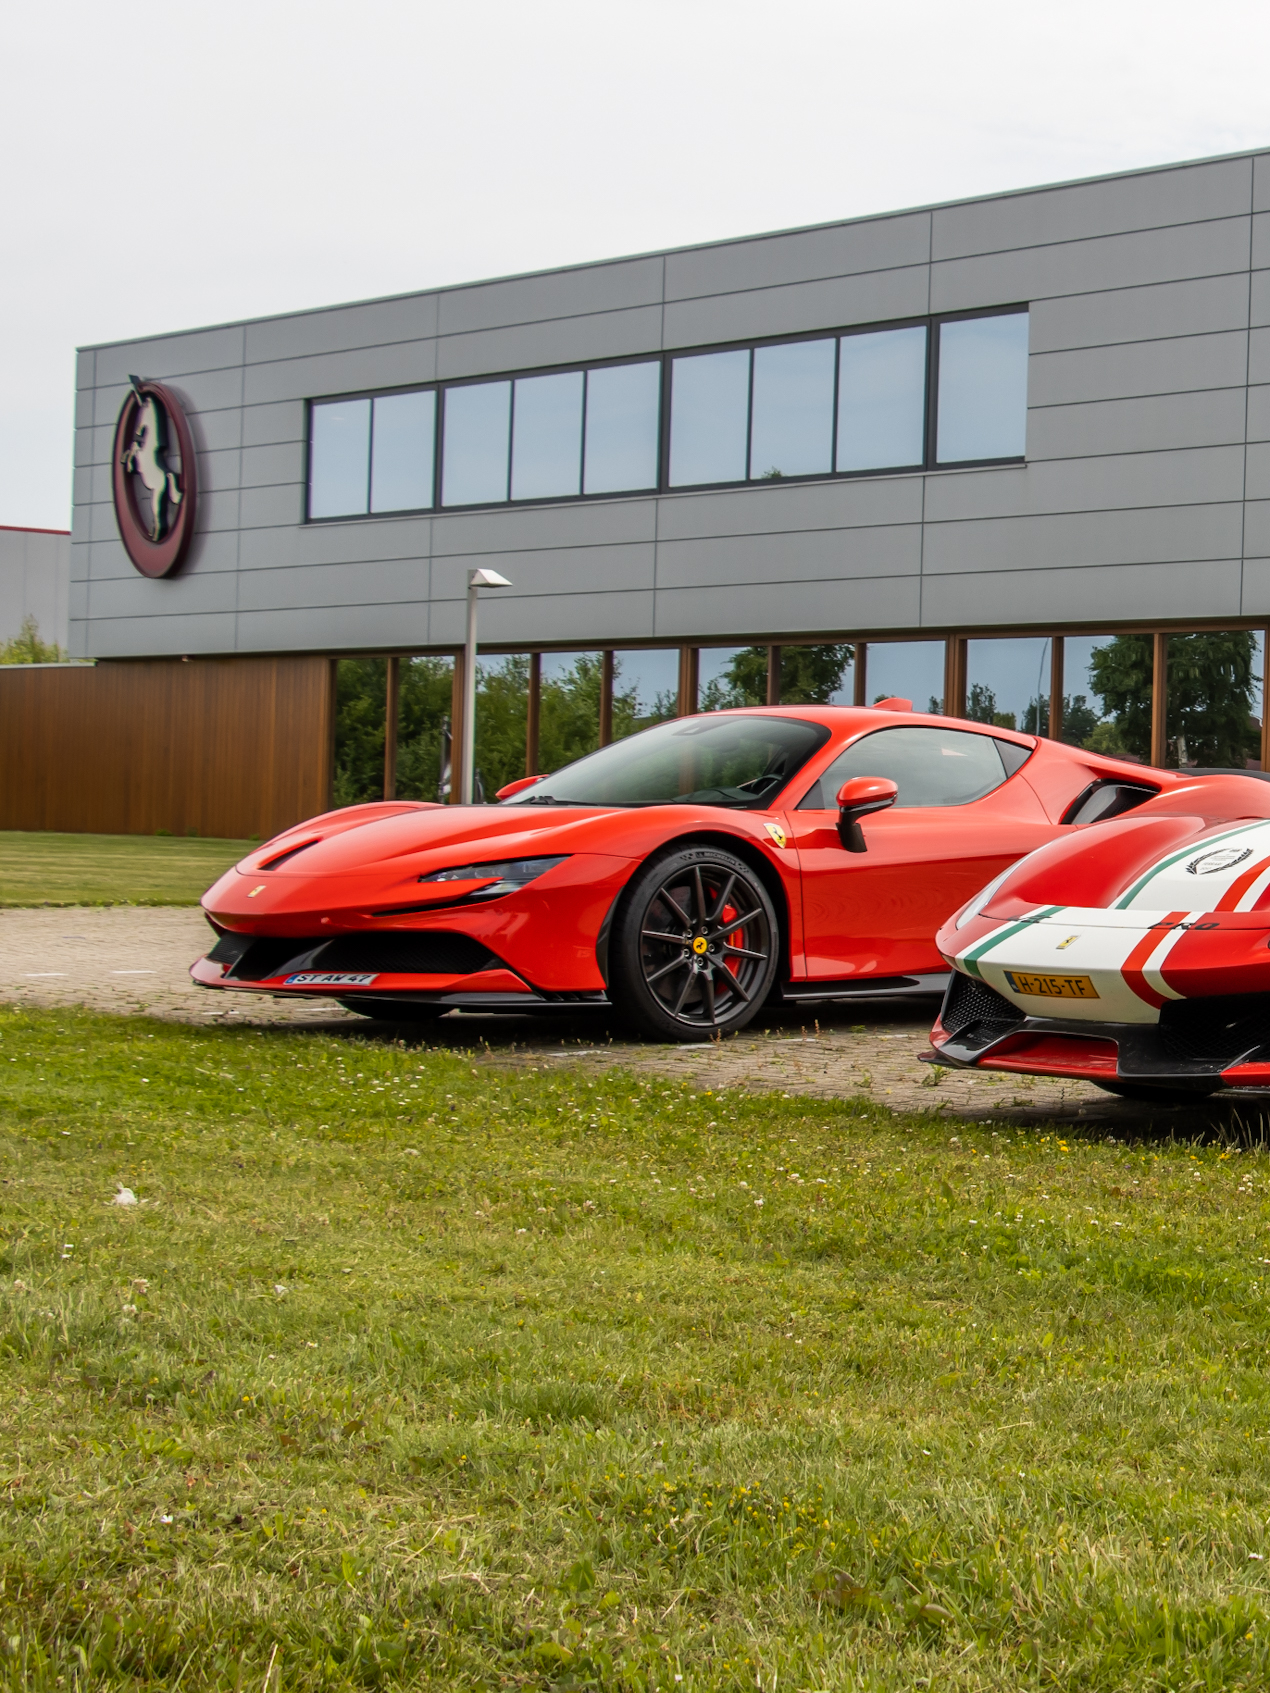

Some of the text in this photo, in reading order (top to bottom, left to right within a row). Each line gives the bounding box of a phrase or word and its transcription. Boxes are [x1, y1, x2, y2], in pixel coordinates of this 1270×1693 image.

[296, 974, 321, 982] ST
[347, 974, 372, 983] 47
[1018, 976, 1086, 996] H-215-TF
